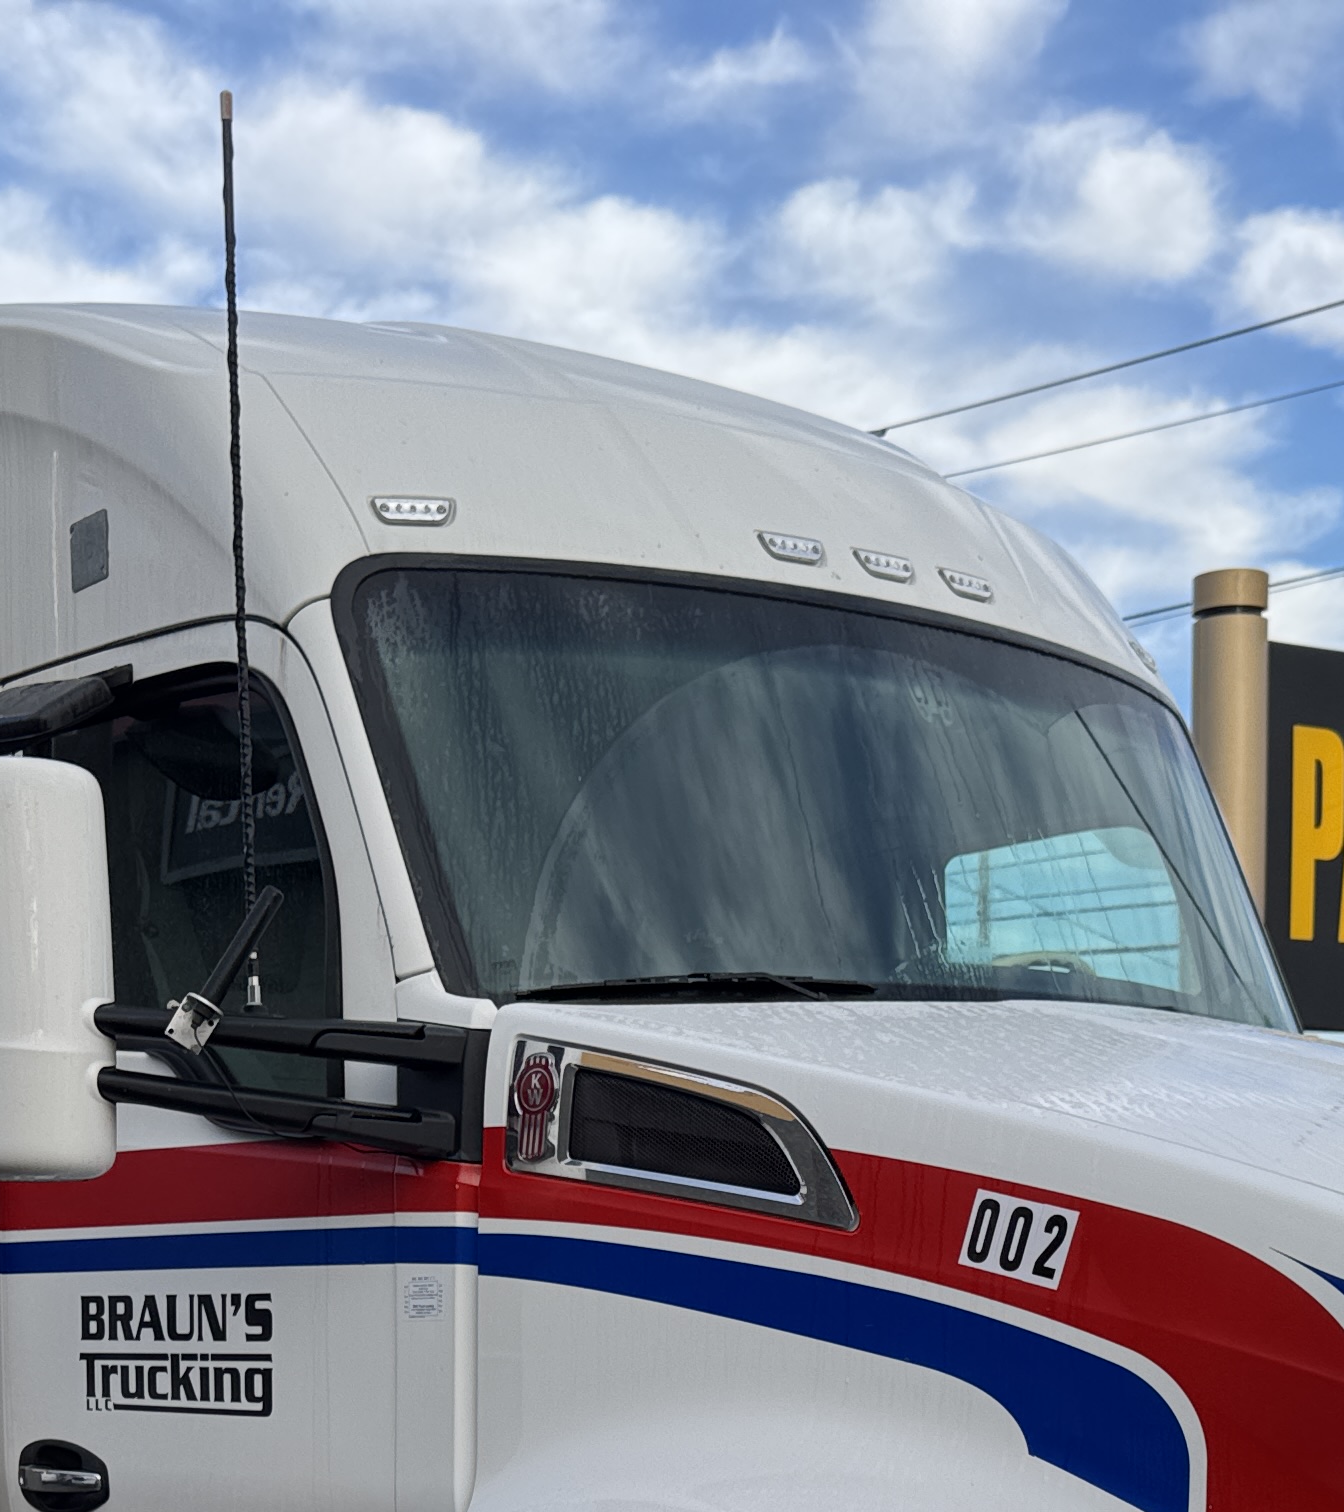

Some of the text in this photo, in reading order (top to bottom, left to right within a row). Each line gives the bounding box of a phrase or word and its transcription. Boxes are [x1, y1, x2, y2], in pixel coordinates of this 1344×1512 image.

[967, 1198, 1068, 1280] 002
[80, 1293, 273, 1342] BRAUN'S
[79, 1352, 273, 1418] Trucking
[86, 1398, 113, 1412] LLC
